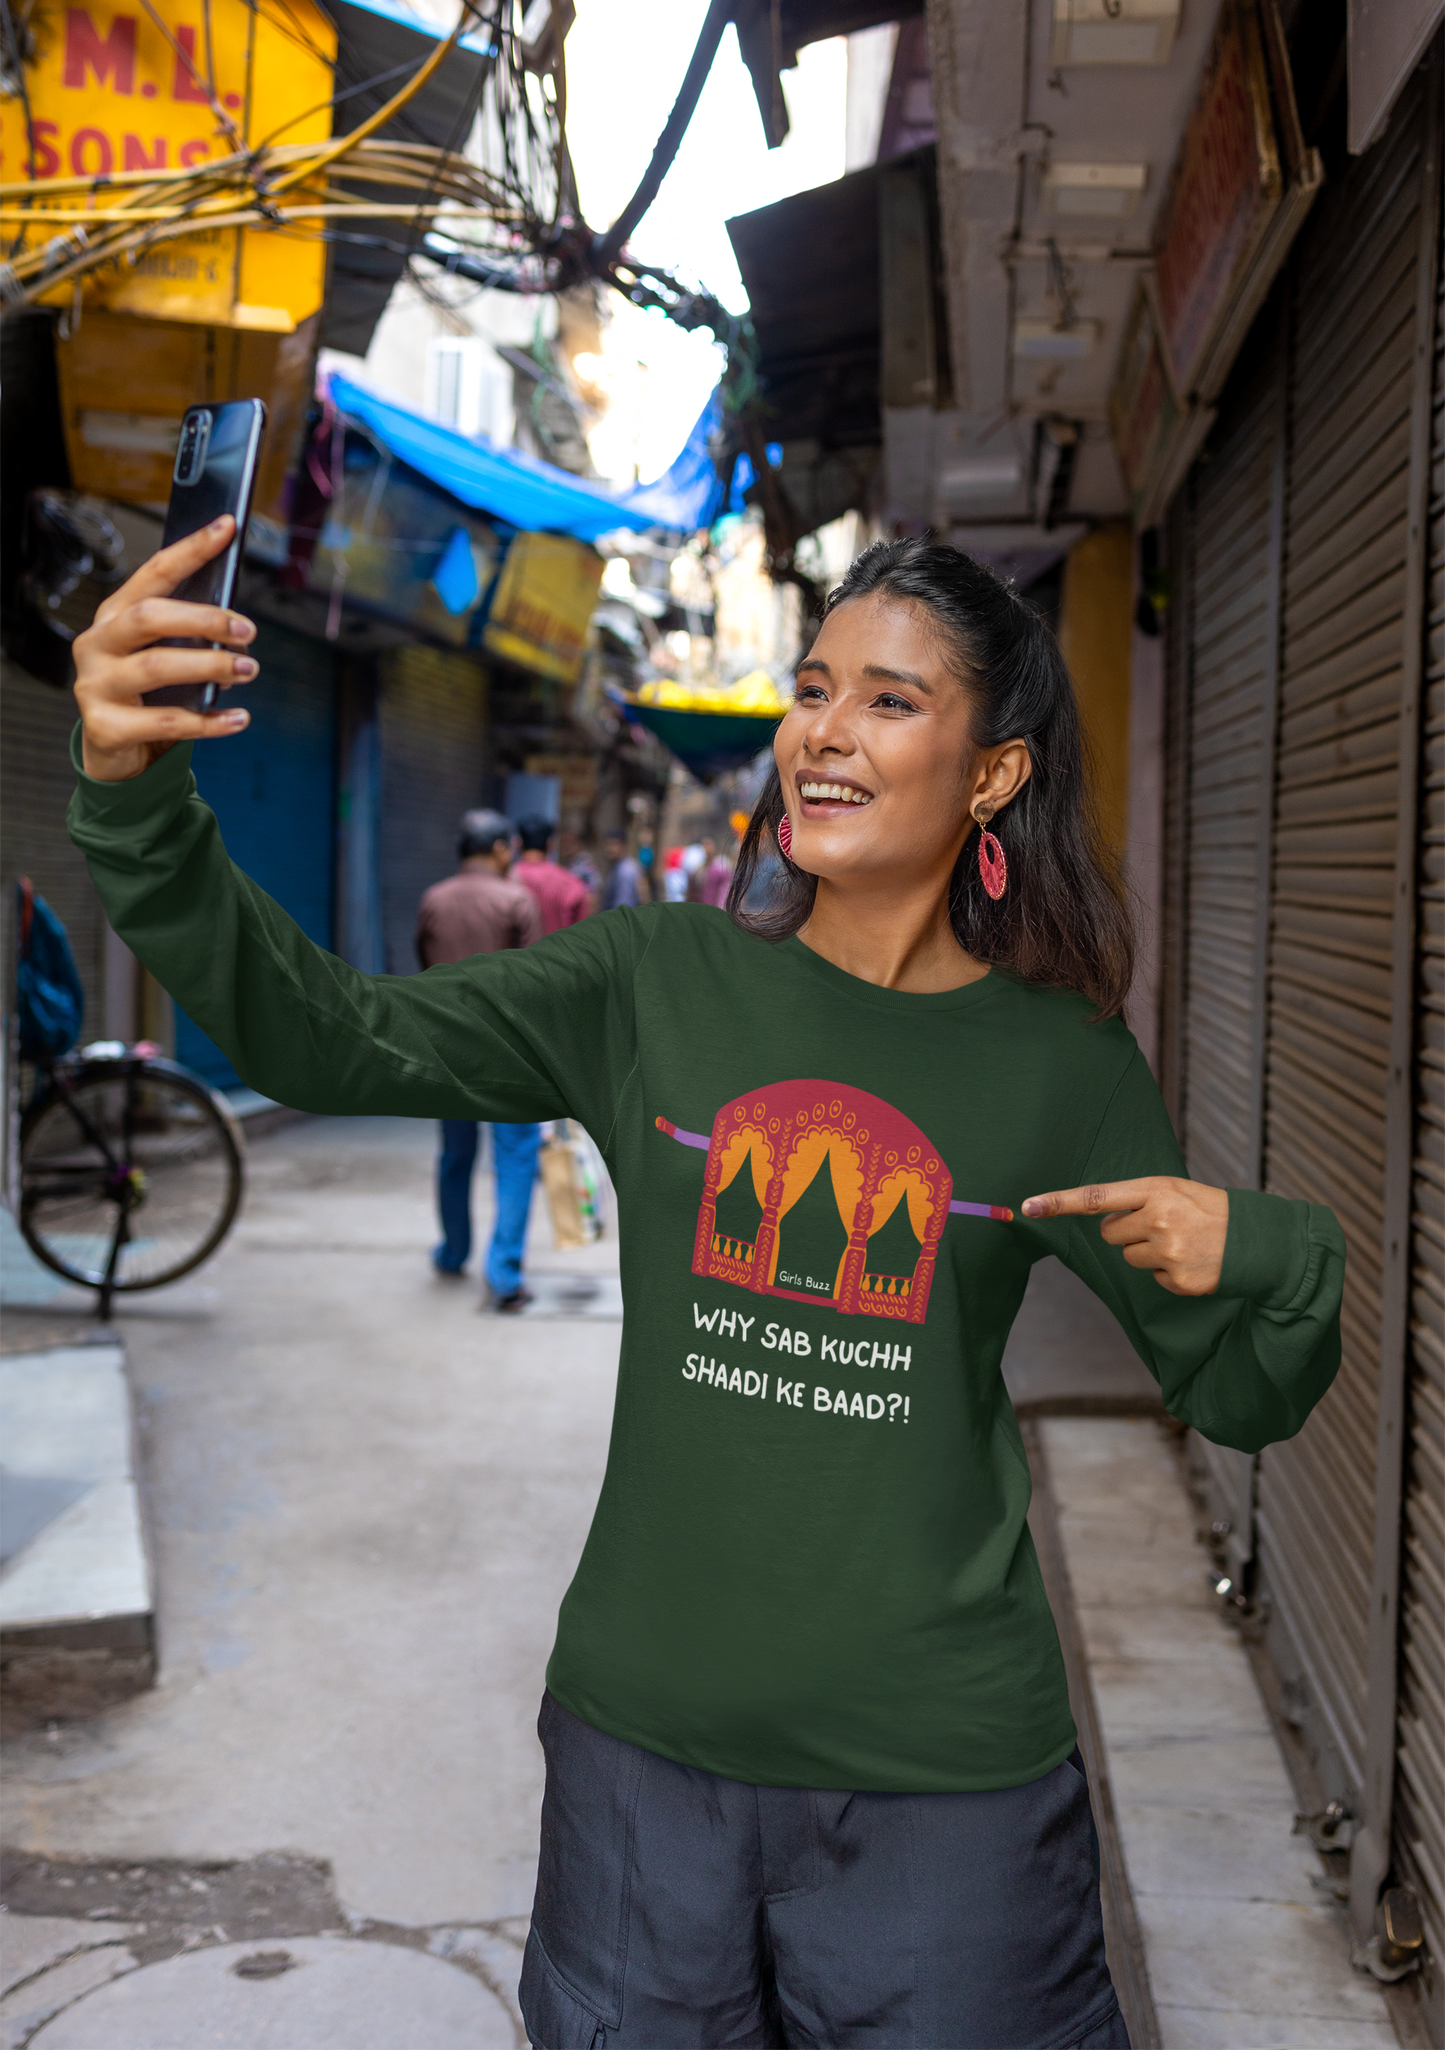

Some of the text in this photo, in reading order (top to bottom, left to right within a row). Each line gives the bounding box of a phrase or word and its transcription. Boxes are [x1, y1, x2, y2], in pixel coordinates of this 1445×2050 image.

[779, 1270, 831, 1291] Girls Buzz
[693, 1302, 912, 1372] WHY SAB KUCHH
[681, 1353, 910, 1424] SHAADI KE BAAD?!
